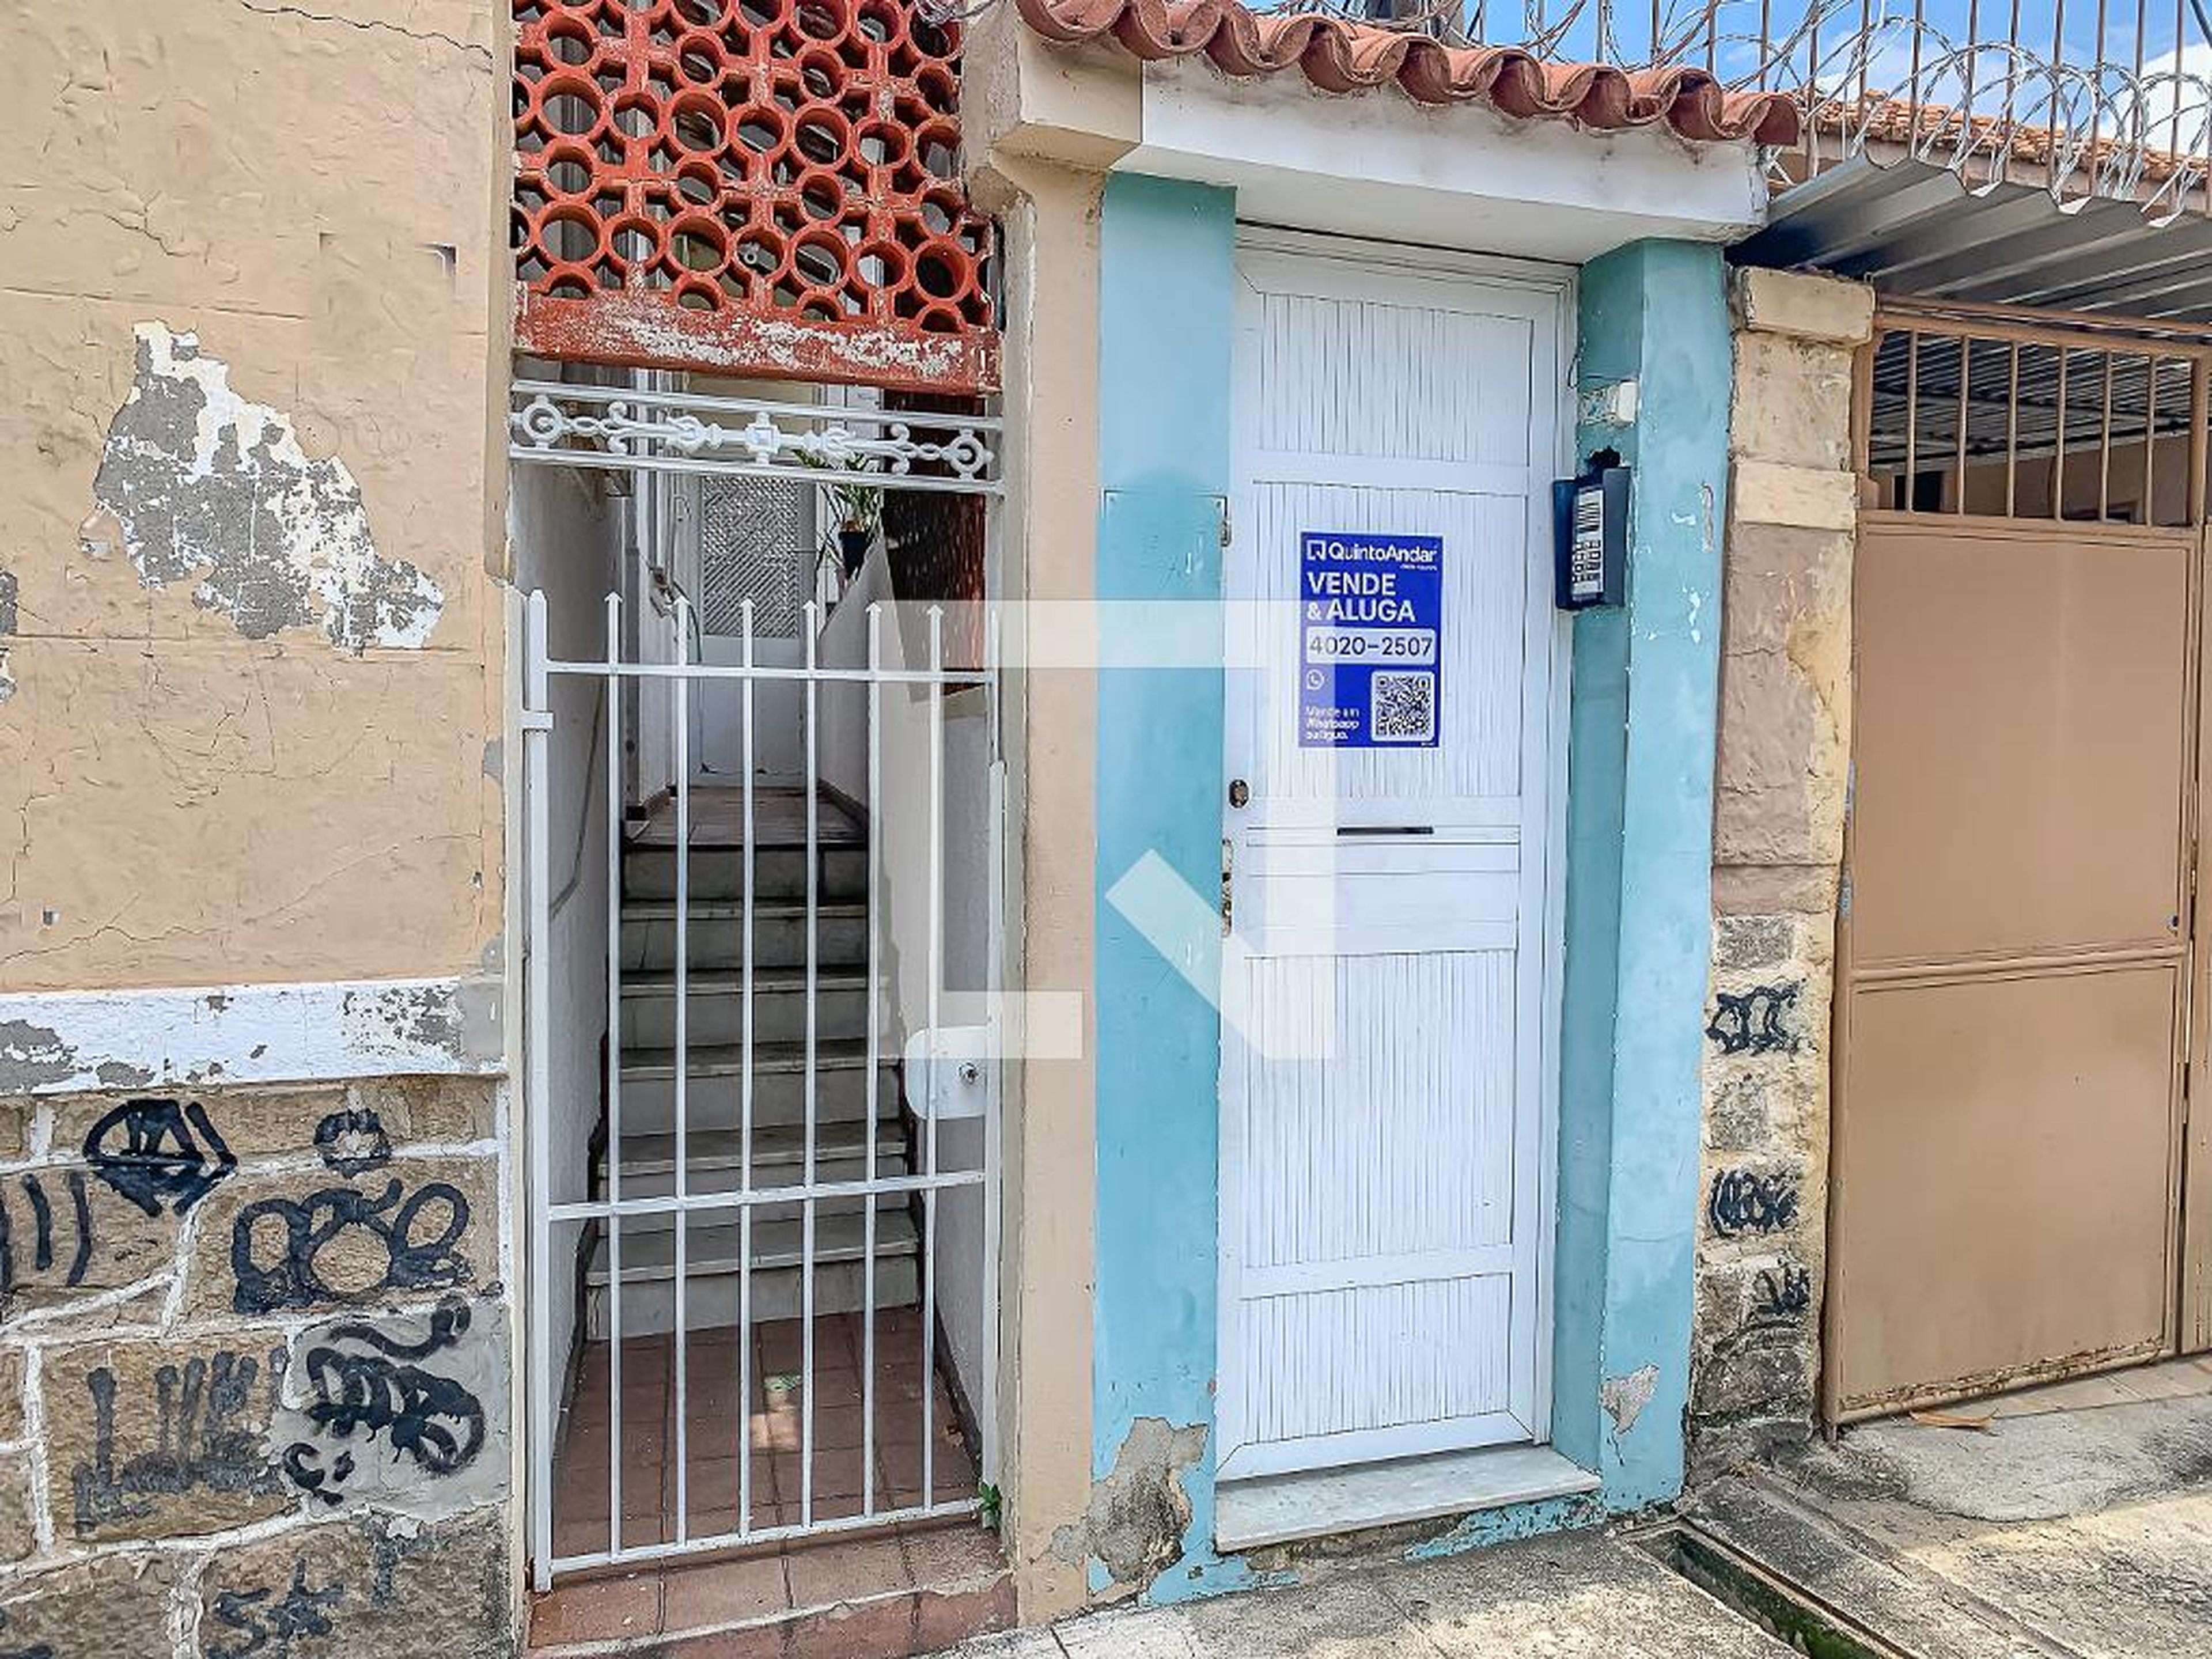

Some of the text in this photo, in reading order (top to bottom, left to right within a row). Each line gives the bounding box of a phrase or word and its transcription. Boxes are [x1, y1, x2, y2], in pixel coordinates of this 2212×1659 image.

[1328, 541, 1437, 563] QuintoAndar
[1306, 571, 1396, 596] VENDE
[1306, 598, 1416, 622] & ALUGA
[1309, 637, 1433, 657] 4020-2507
